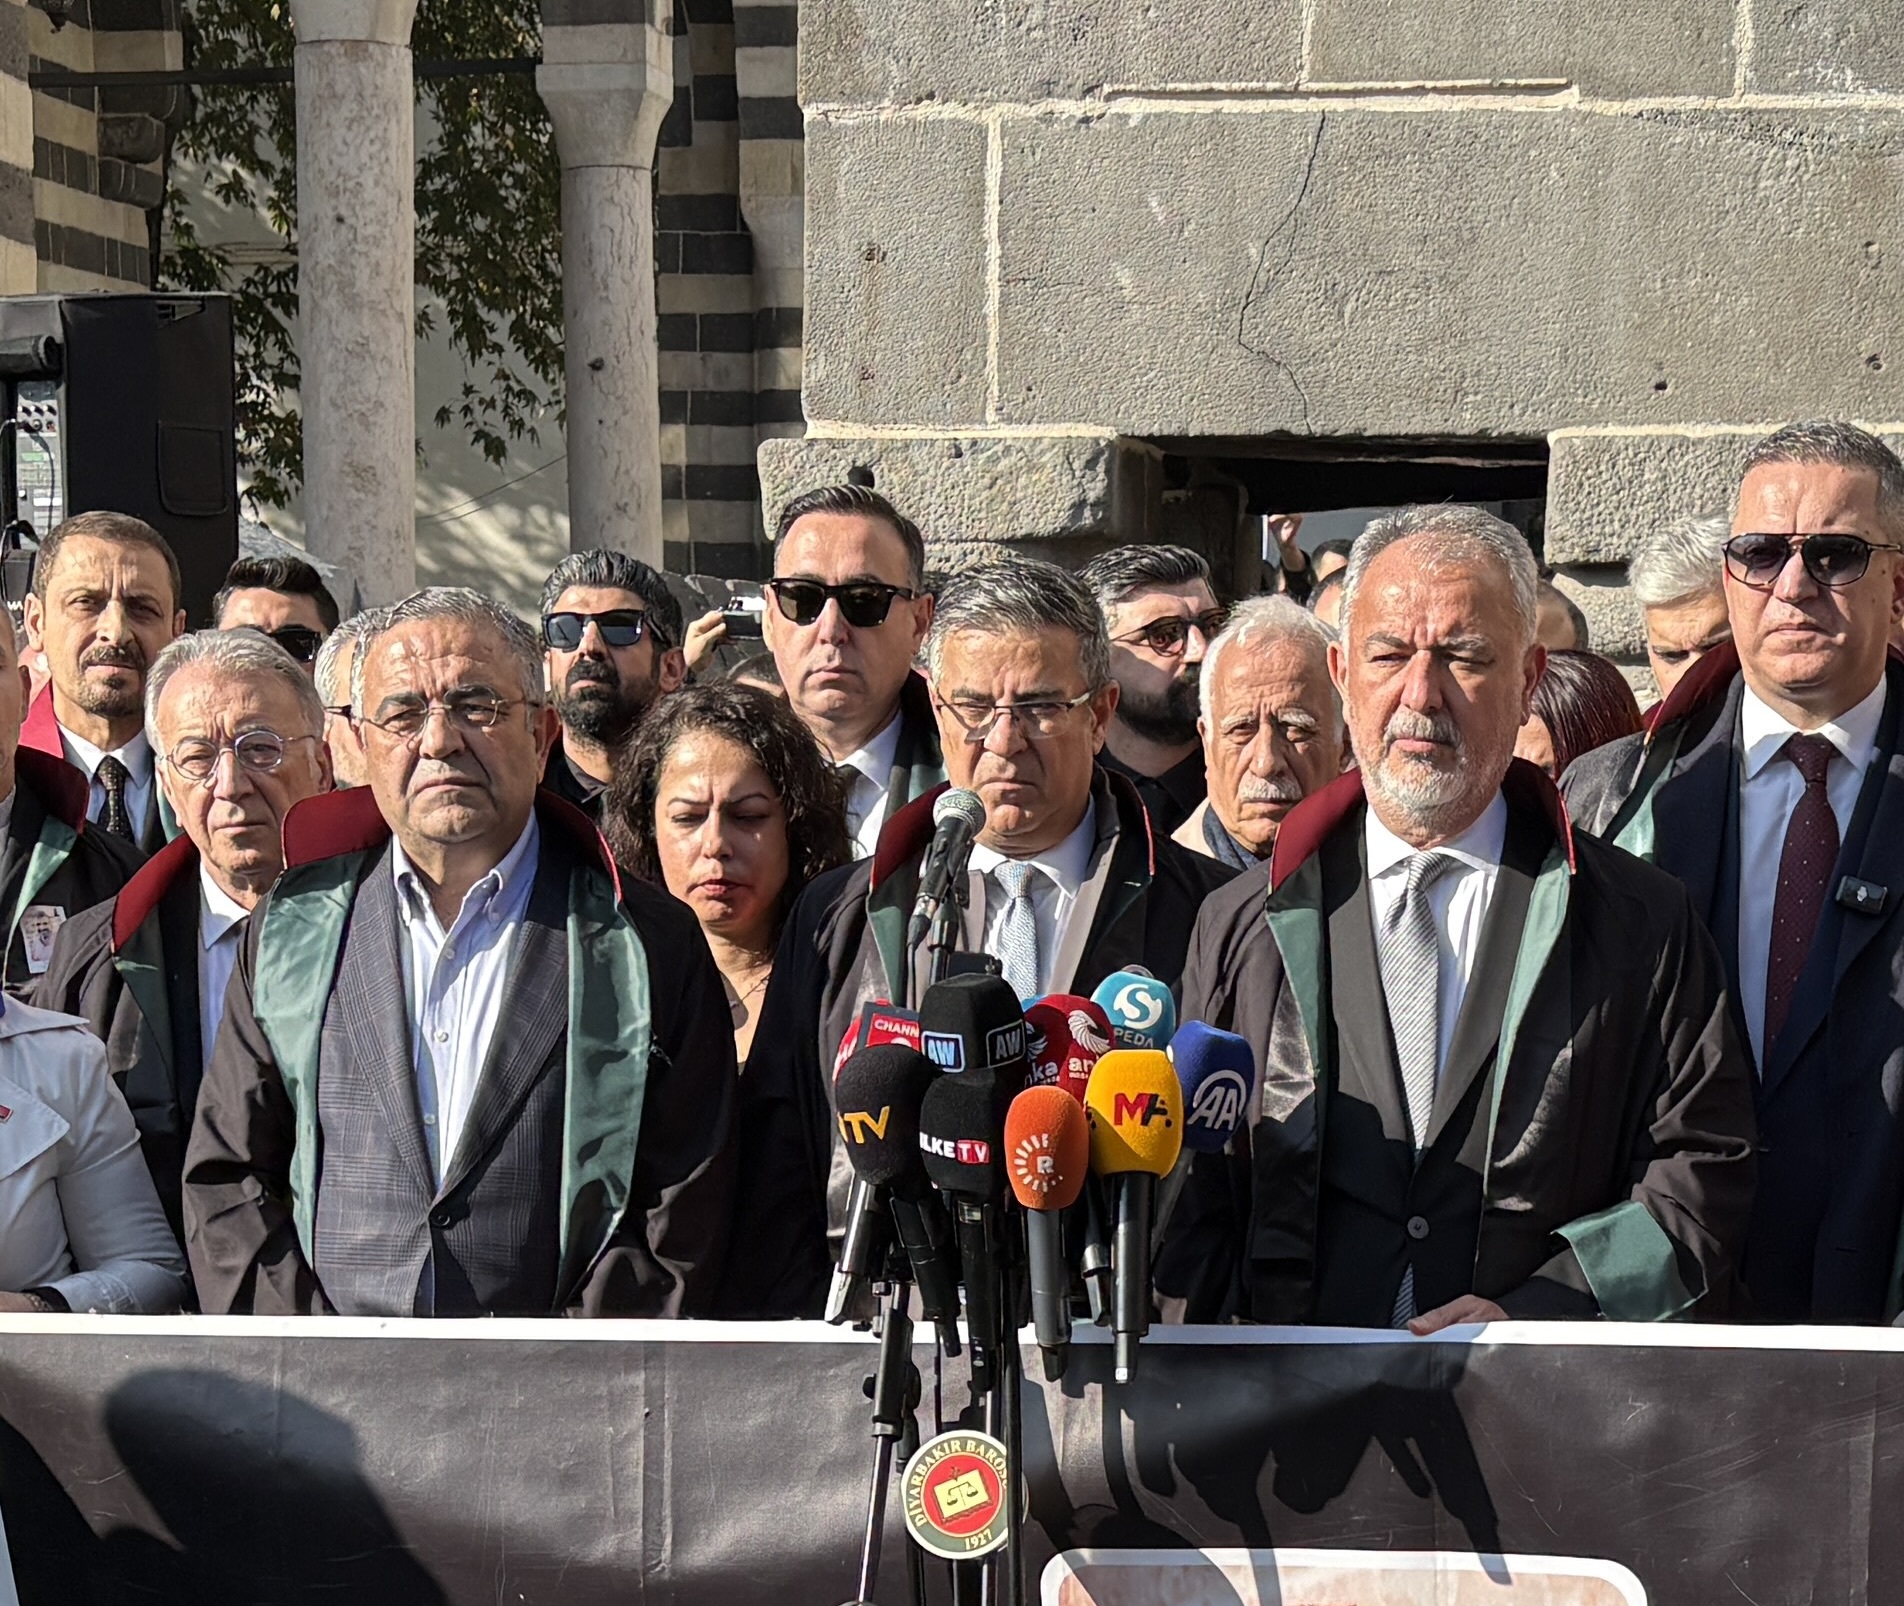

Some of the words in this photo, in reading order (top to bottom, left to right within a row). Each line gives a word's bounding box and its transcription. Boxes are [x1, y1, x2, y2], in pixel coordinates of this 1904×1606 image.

[996, 1028, 1021, 1060] AW
[1187, 1086, 1234, 1131] AA
[964, 1528, 993, 1550] 1927
